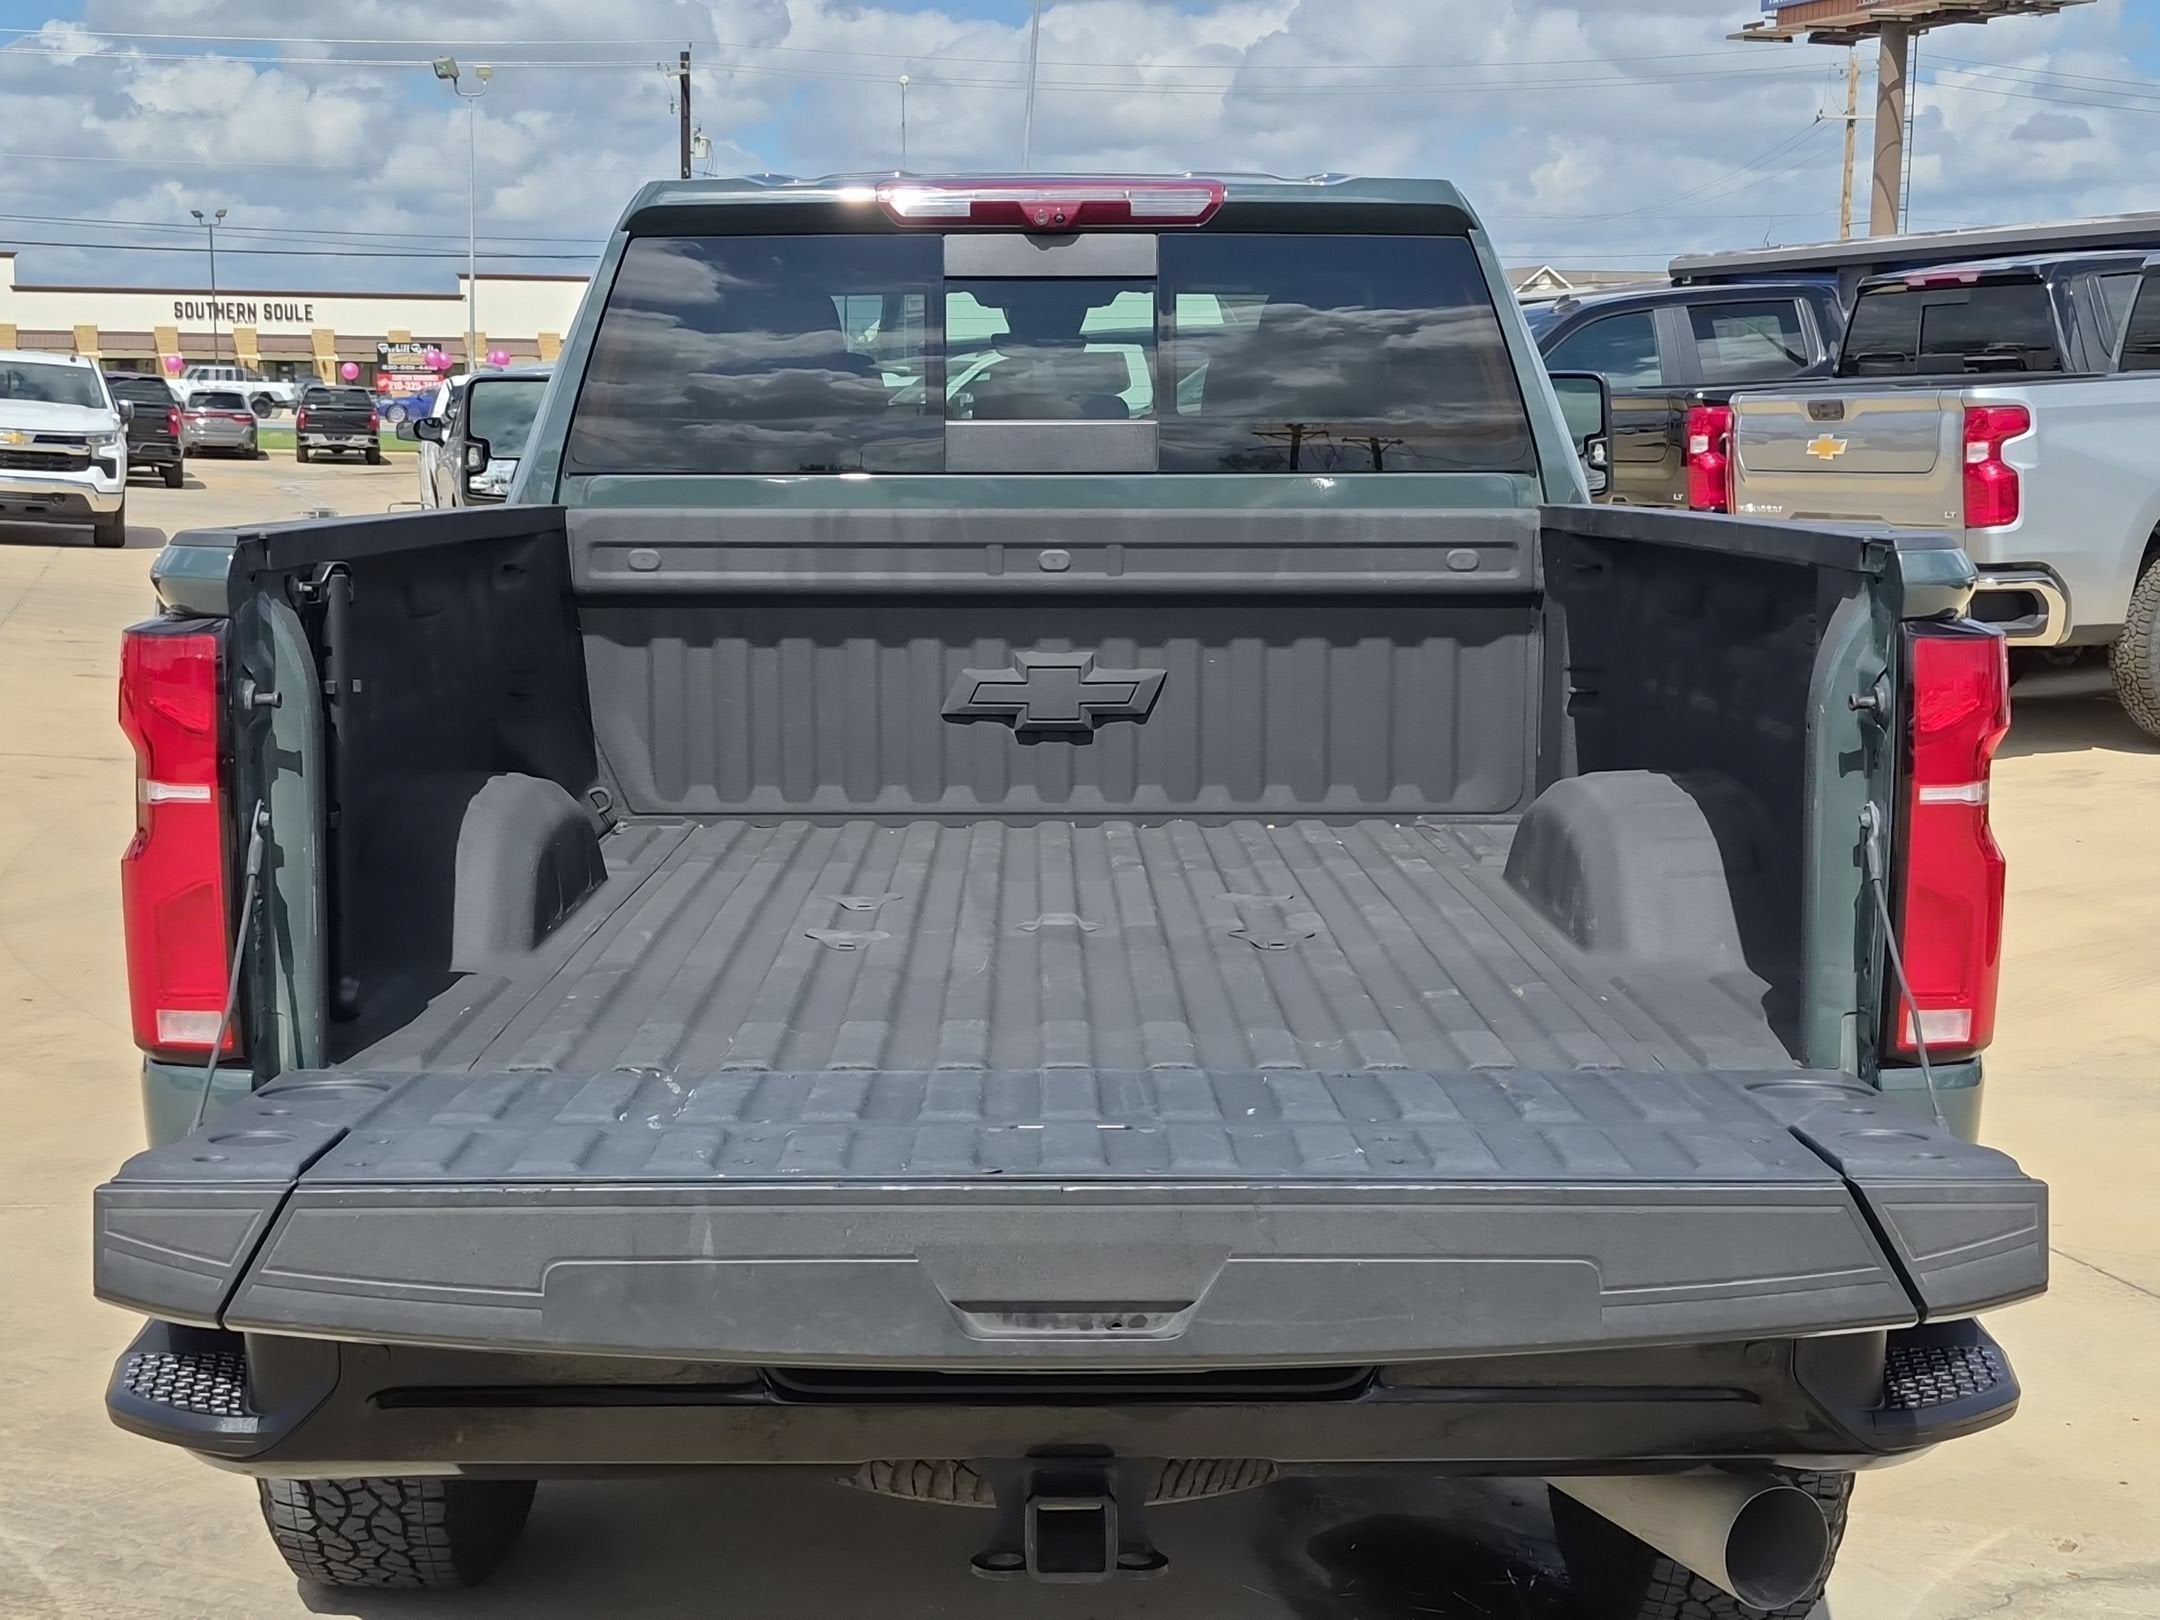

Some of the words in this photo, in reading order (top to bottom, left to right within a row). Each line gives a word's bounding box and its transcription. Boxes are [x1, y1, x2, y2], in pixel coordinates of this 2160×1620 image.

[174, 301, 257, 322] SOUTHERN
[263, 303, 314, 321] SOULE
[1673, 493, 1684, 501] LT
[1944, 511, 1957, 519] LT
